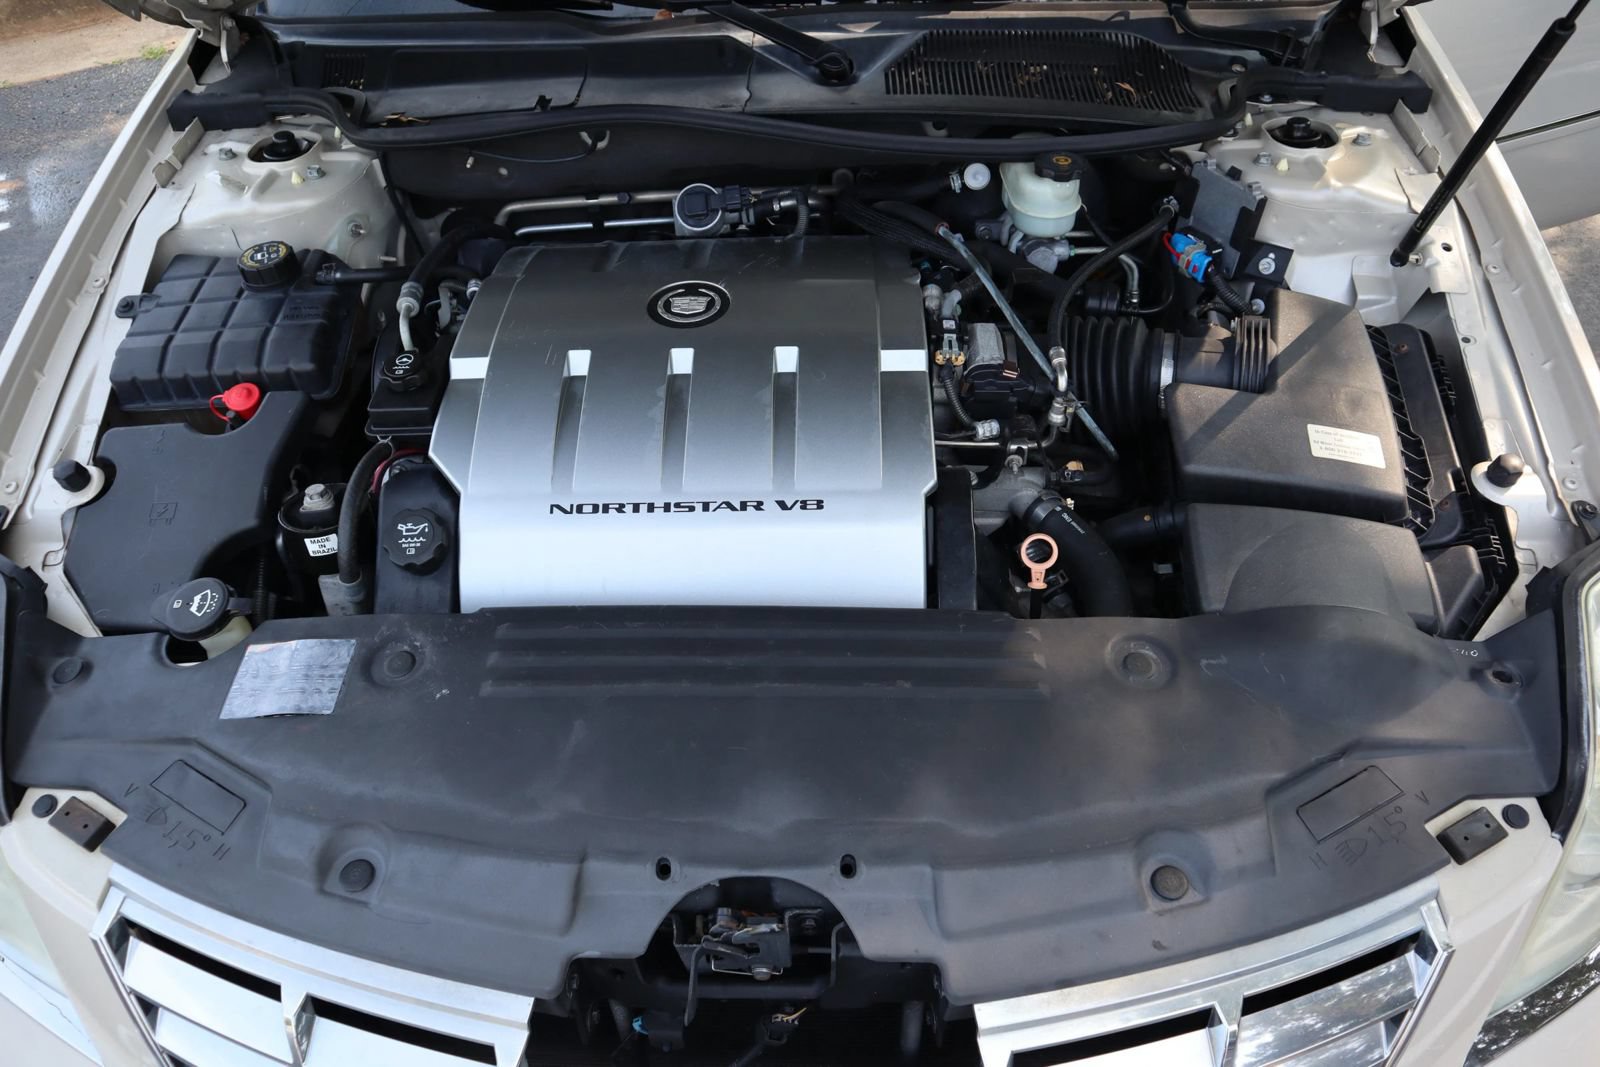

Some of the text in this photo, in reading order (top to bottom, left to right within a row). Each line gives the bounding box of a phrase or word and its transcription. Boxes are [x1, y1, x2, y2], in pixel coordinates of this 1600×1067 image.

[550, 499, 825, 514] NORTHSTAR V8
[312, 547, 337, 555] BRAZIL
